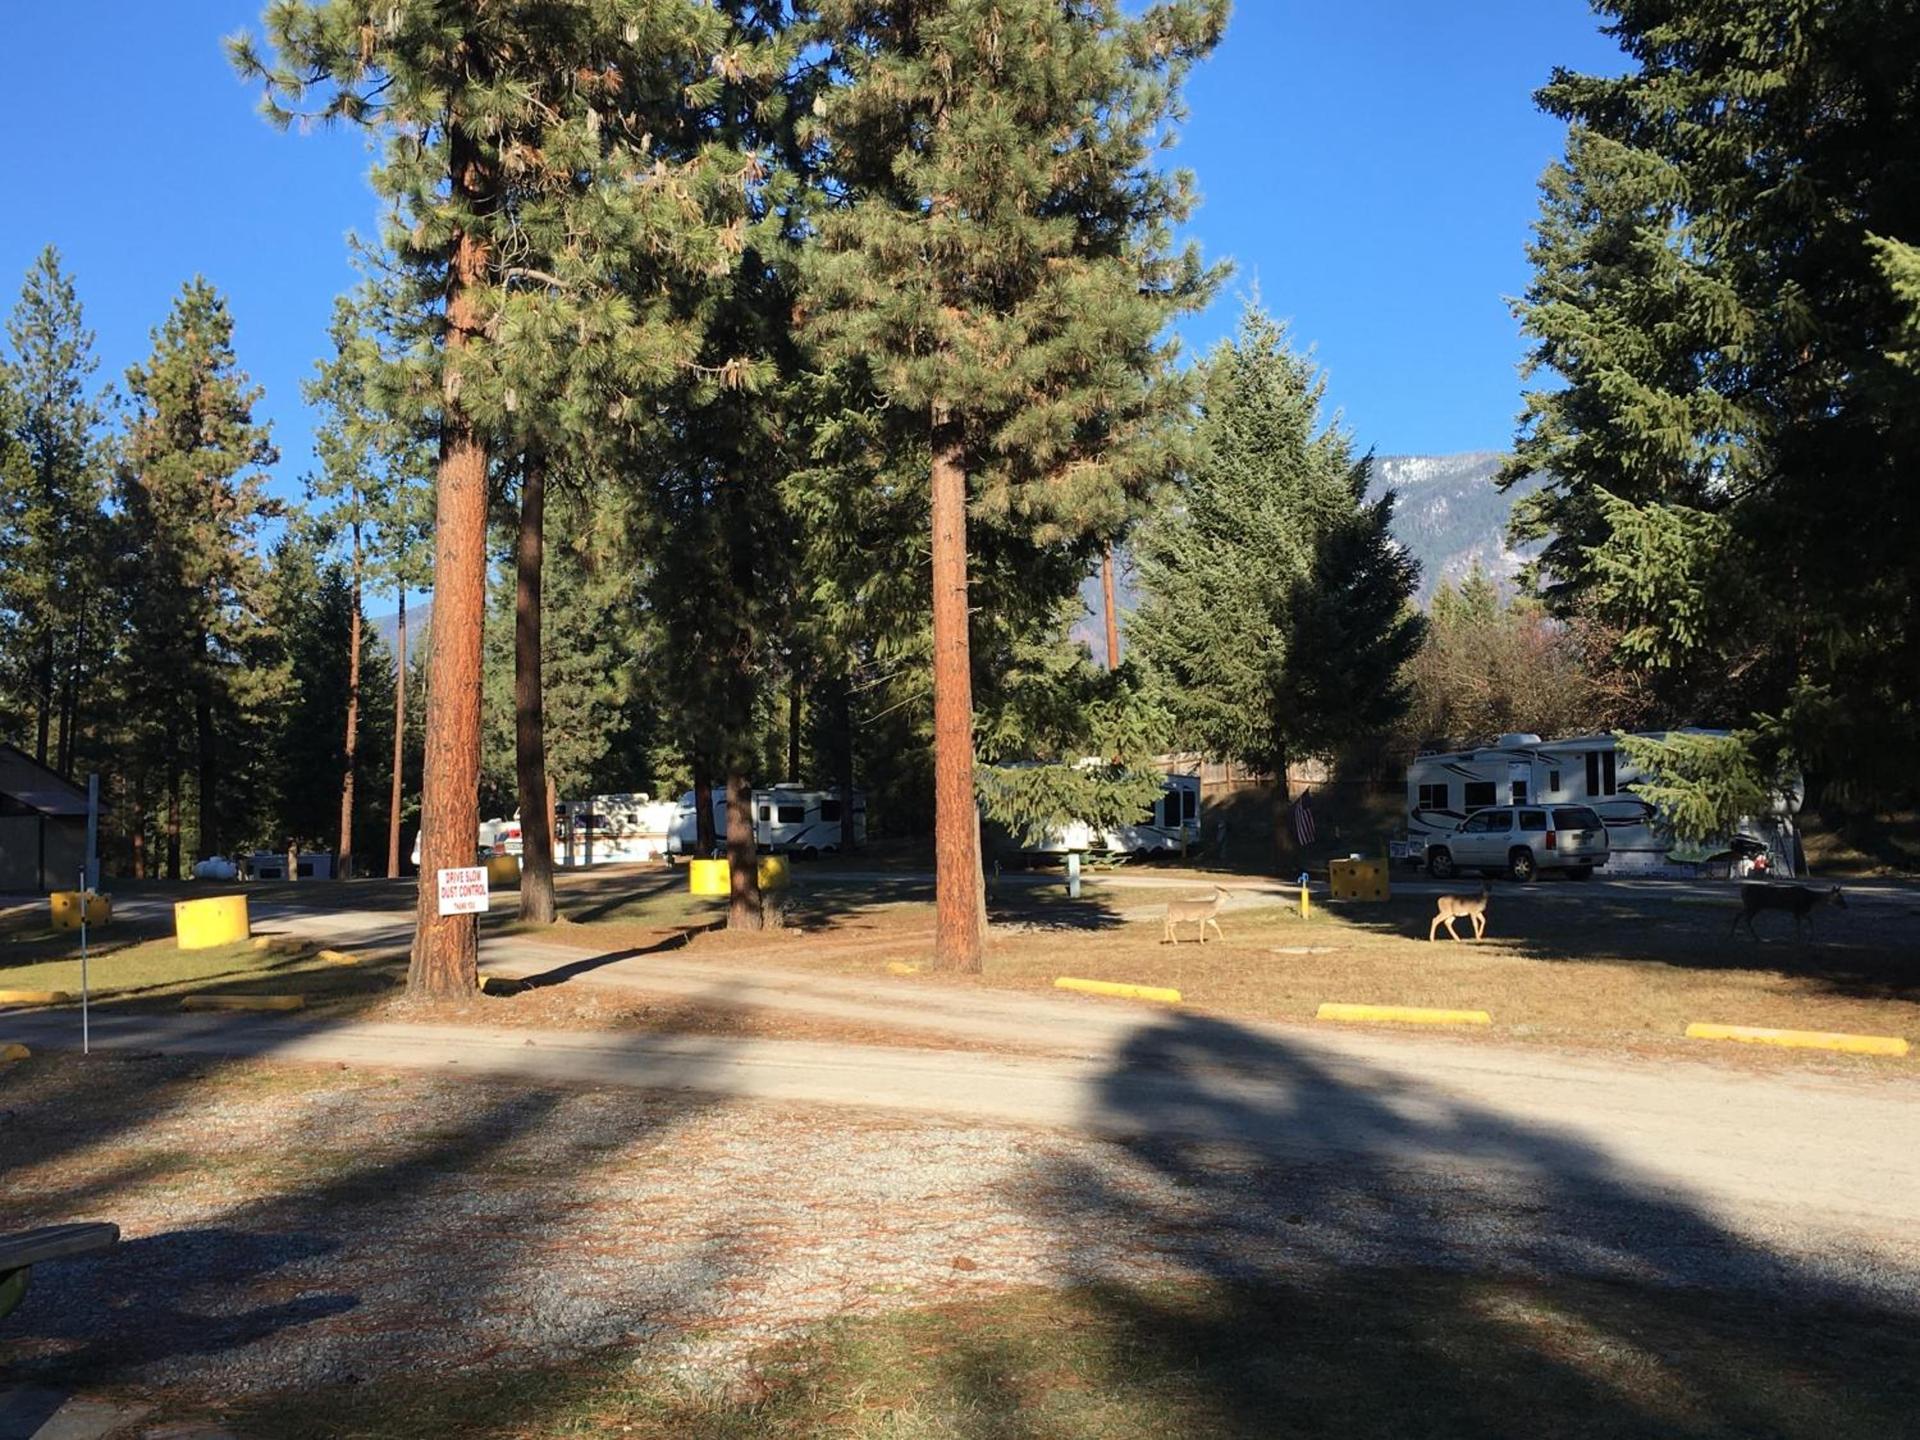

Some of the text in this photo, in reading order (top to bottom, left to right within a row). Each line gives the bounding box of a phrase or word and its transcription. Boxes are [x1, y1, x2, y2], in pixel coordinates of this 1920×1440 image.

[445, 869, 482, 884] DRIVE SLOW
[441, 884, 487, 898] DUST CONTROL
